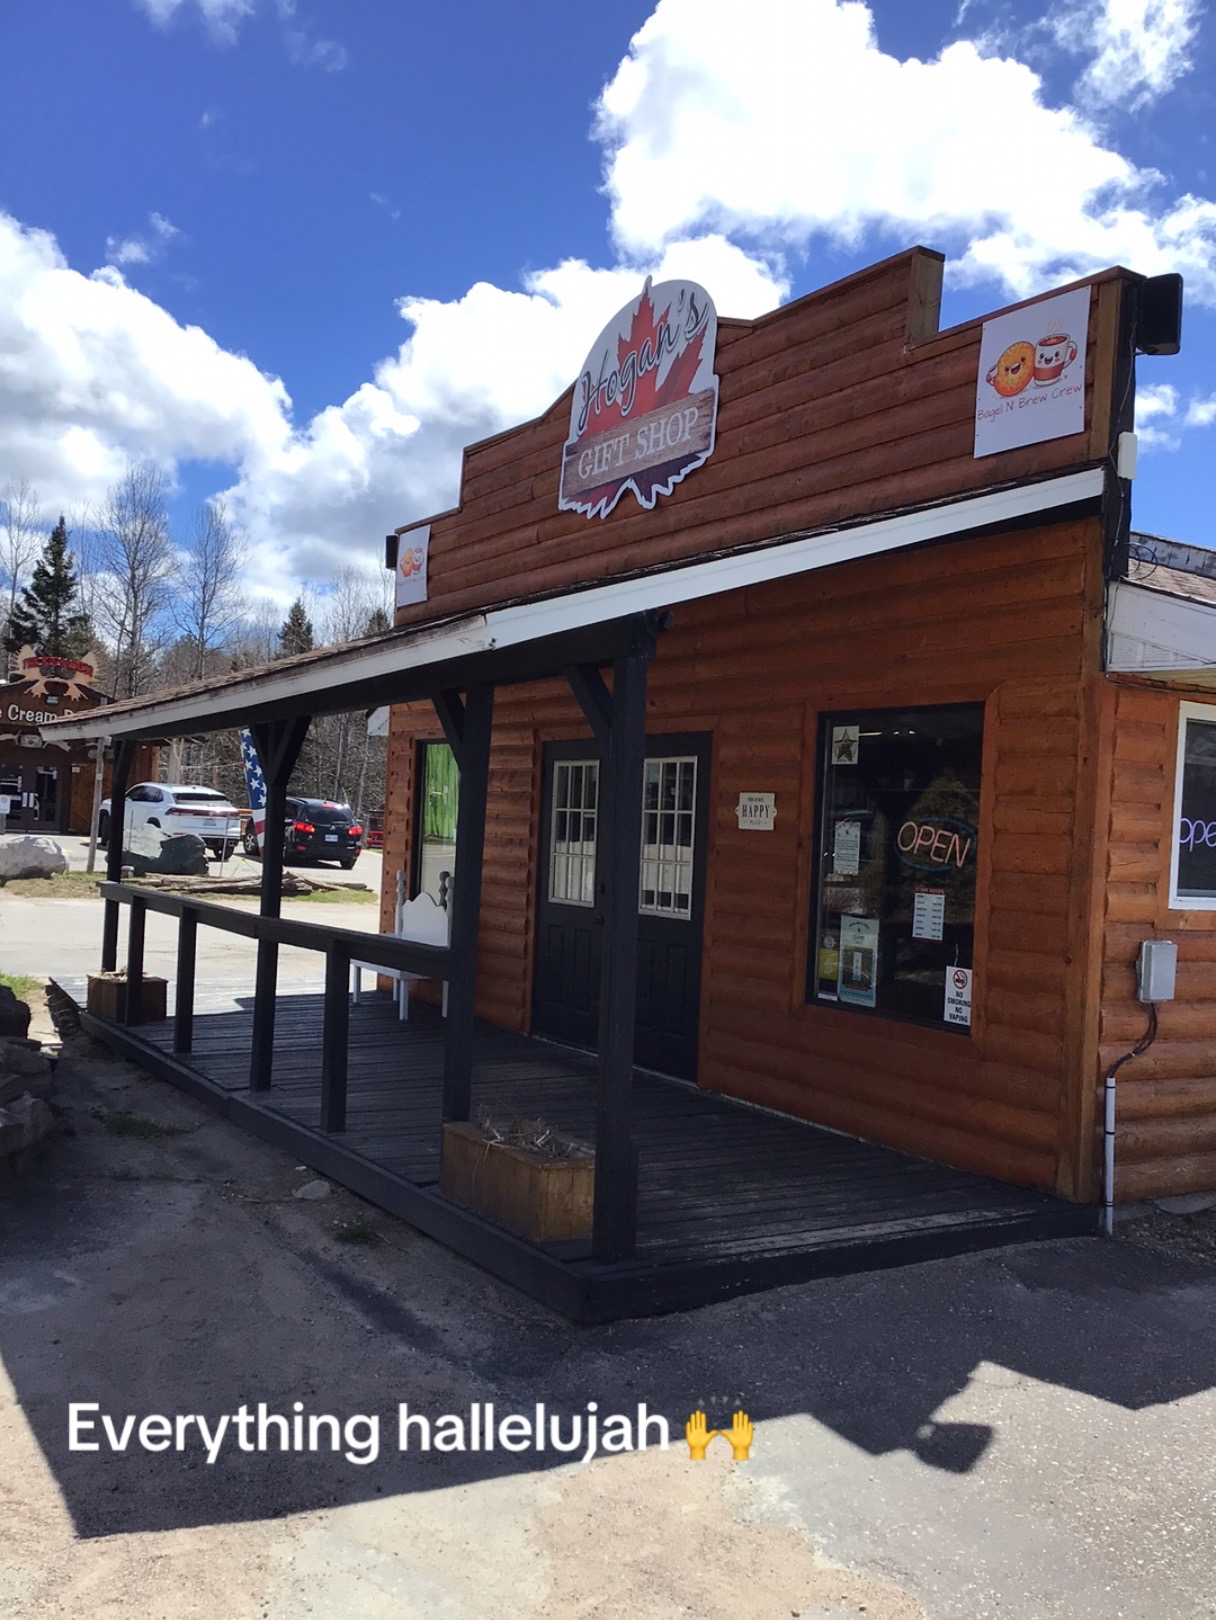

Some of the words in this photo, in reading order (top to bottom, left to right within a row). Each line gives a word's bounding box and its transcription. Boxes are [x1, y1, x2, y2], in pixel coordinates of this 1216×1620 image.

[577, 289, 709, 432] Hogan's
[977, 404, 1003, 423] Bagel
[1005, 401, 1015, 411] N
[1019, 394, 1048, 409] Brew
[1051, 383, 1082, 398] Crew
[578, 433, 631, 480] GIFT
[634, 407, 699, 460] SHOP
[8, 704, 58, 723] Cream
[741, 804, 770, 818] HAPPY
[897, 820, 971, 868] OPEN
[947, 997, 971, 1007] SMOKING
[949, 1013, 968, 1022] VAPING
